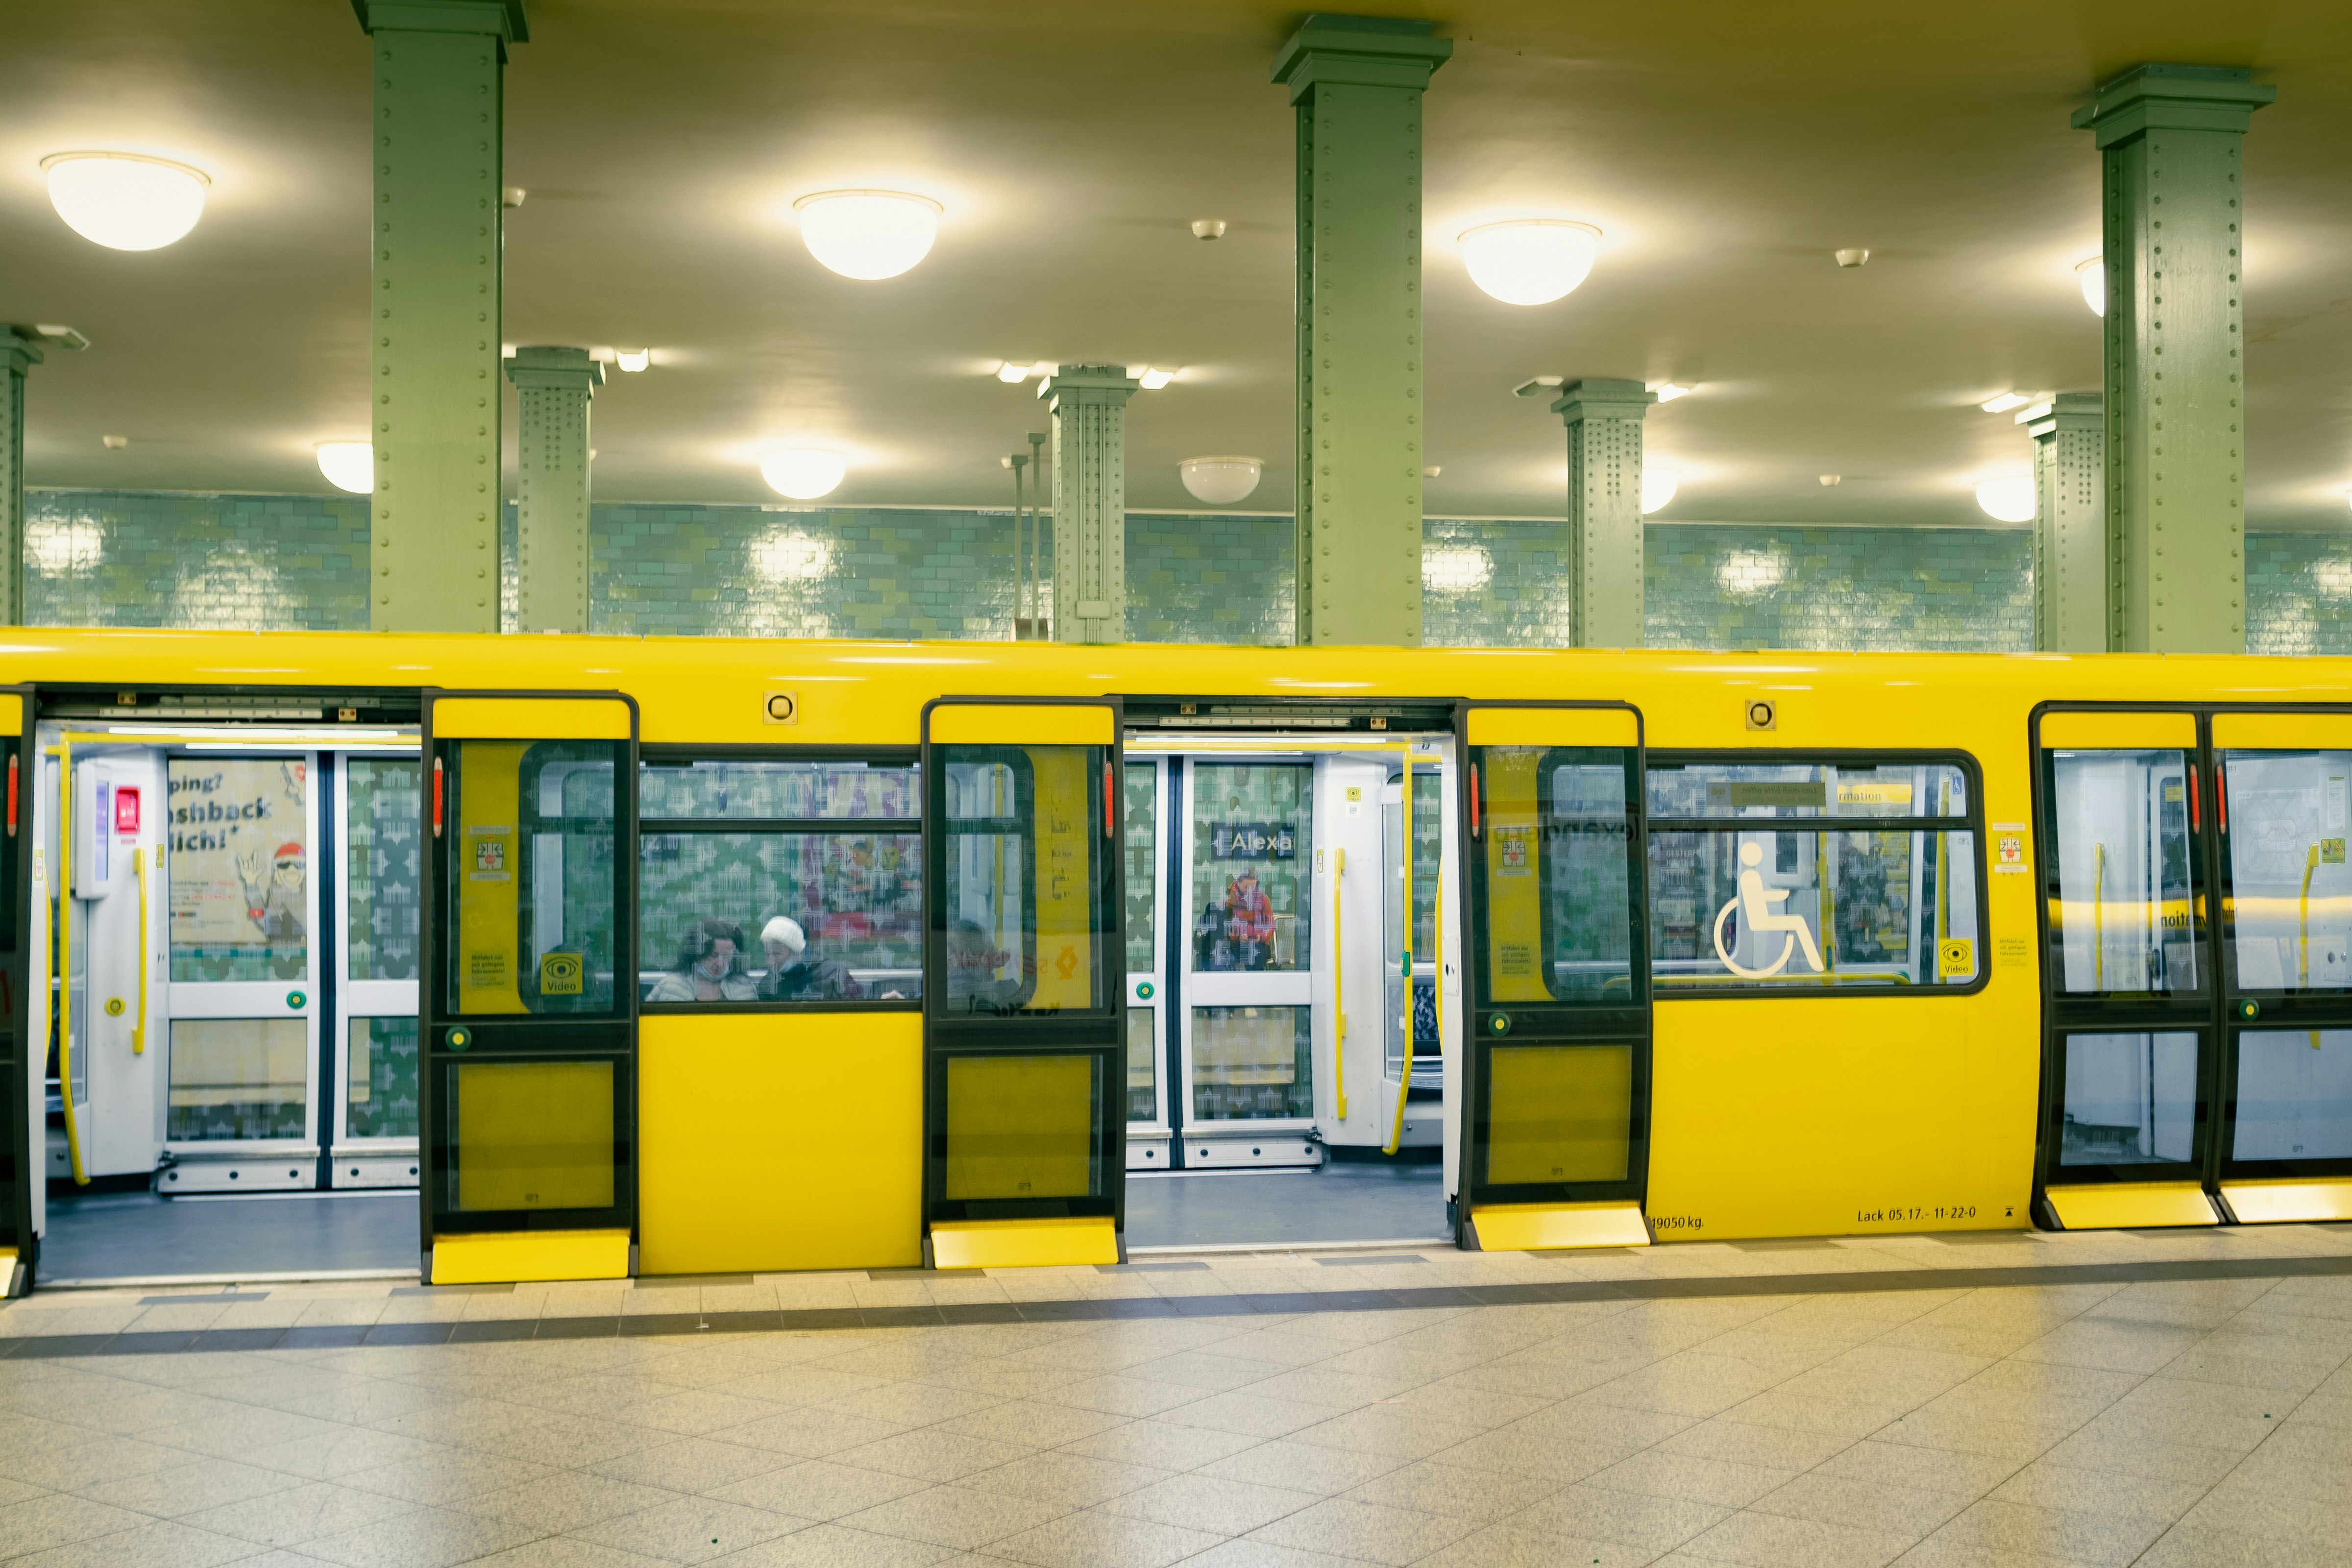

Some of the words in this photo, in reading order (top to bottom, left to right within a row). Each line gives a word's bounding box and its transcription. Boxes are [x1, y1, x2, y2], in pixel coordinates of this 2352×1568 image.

[1232, 832, 1295, 850] Alexa
[1944, 964, 1968, 974] Video
[547, 980, 577, 991] Video
[1858, 1209, 1884, 1222] Lack
